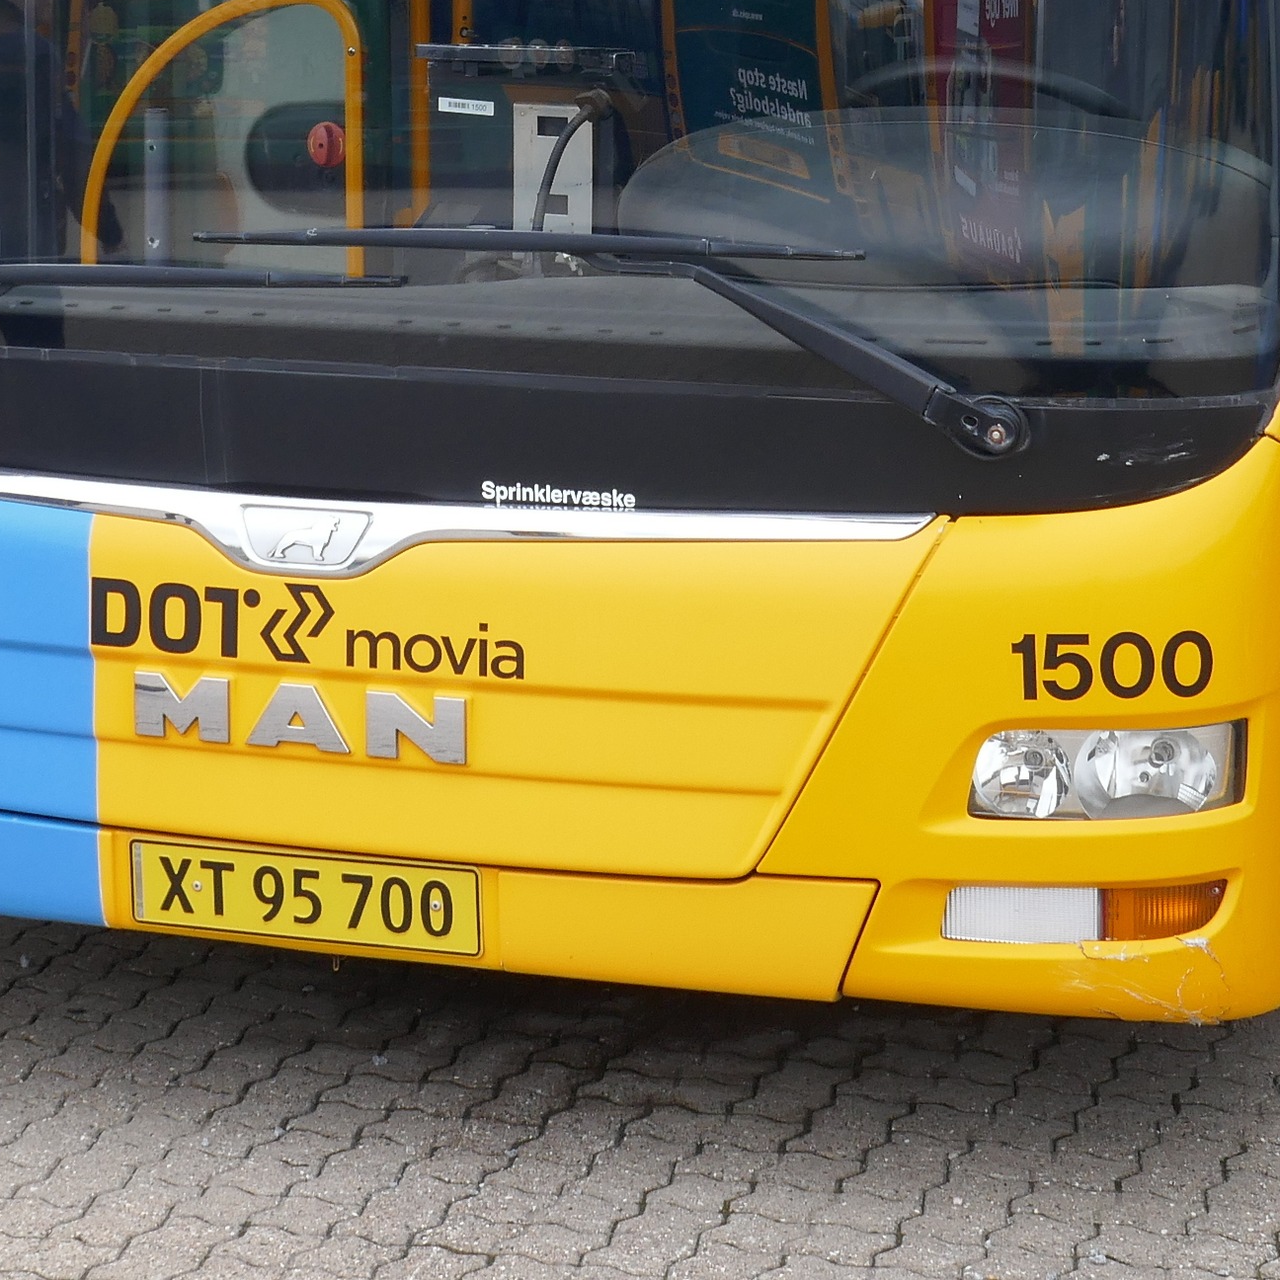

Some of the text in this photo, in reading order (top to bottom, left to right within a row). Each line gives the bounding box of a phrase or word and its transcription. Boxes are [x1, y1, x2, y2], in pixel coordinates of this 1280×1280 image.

[471, 102, 488, 113] 1500
[481, 480, 636, 508] Sprinklervæske
[90, 577, 260, 659] DOT
[346, 623, 525, 681] movia
[1010, 629, 1215, 701] 1500
[133, 670, 470, 767] MAN
[158, 855, 454, 938] XT 95 700
